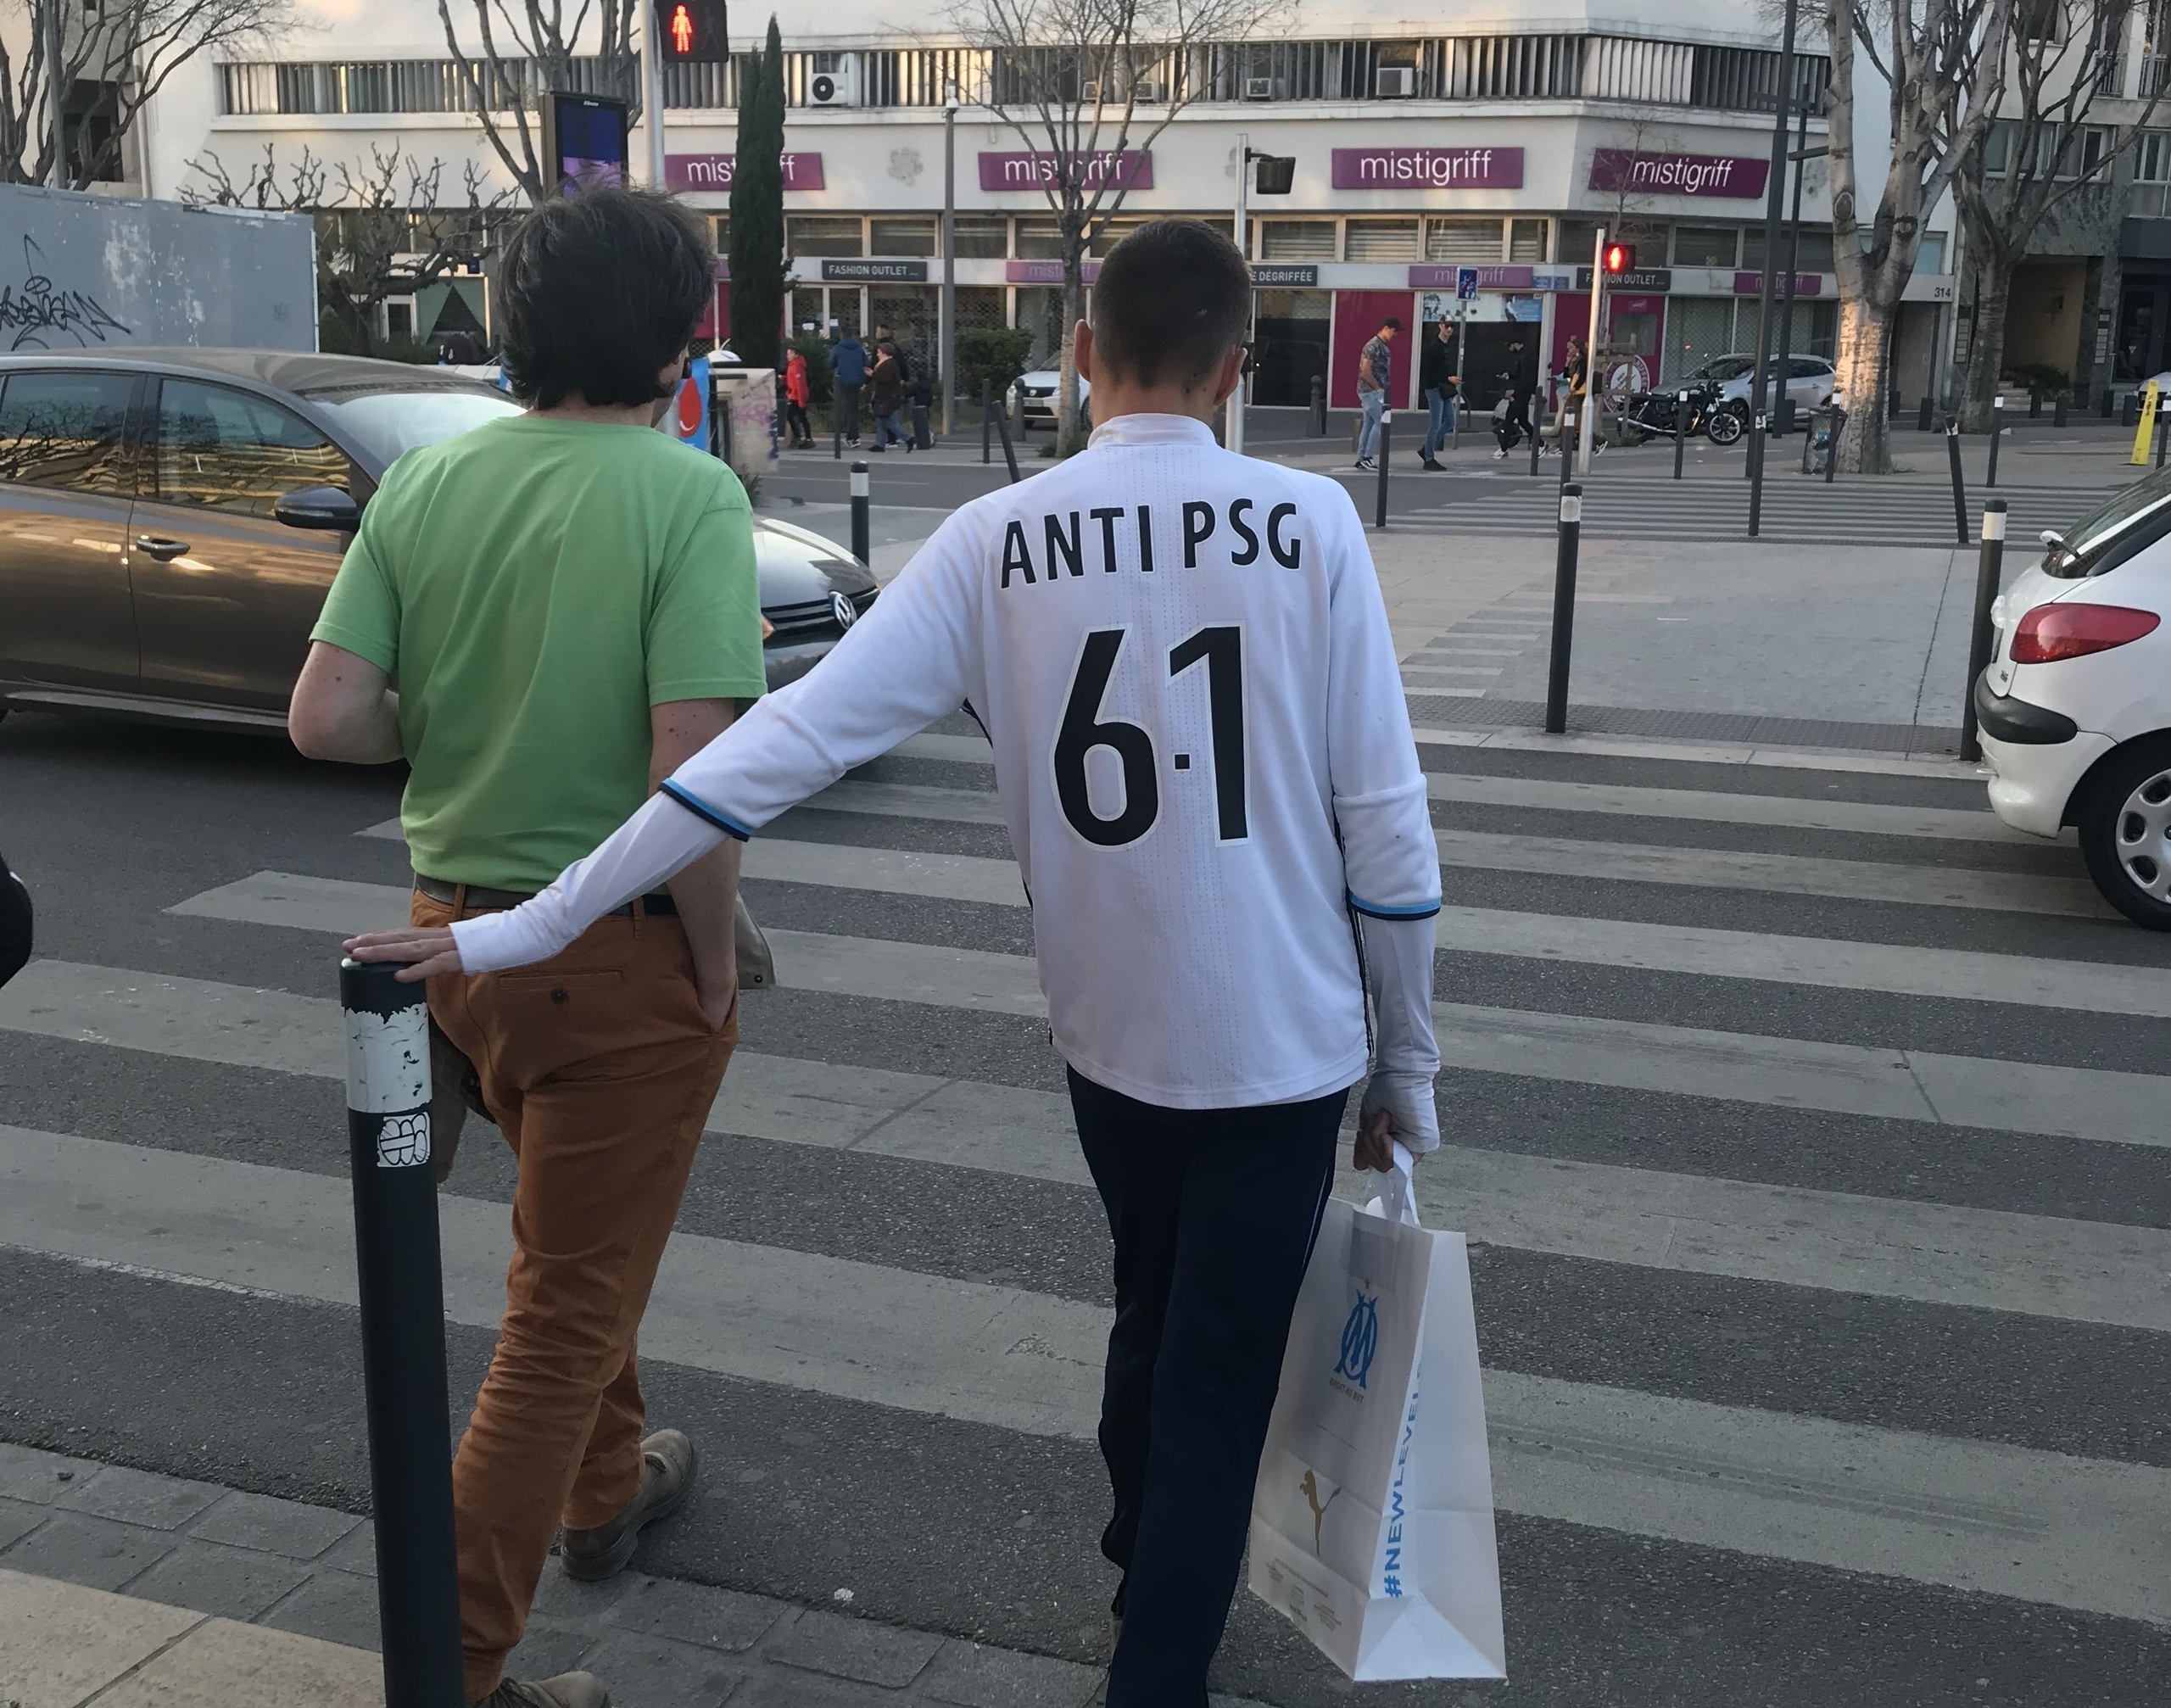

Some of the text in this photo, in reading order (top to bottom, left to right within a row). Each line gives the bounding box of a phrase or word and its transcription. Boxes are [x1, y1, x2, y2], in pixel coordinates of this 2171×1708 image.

[1360, 150, 1492, 186] mistigriff
[1632, 157, 1734, 193] mistigriff
[829, 265, 907, 276] FASHION OUTLET
[1259, 269, 1313, 282] DÉGRIFFÉE
[1624, 274, 1656, 285] OUTLET
[1934, 287, 1951, 298] 314
[1001, 497, 1303, 589] ANTI PSG
